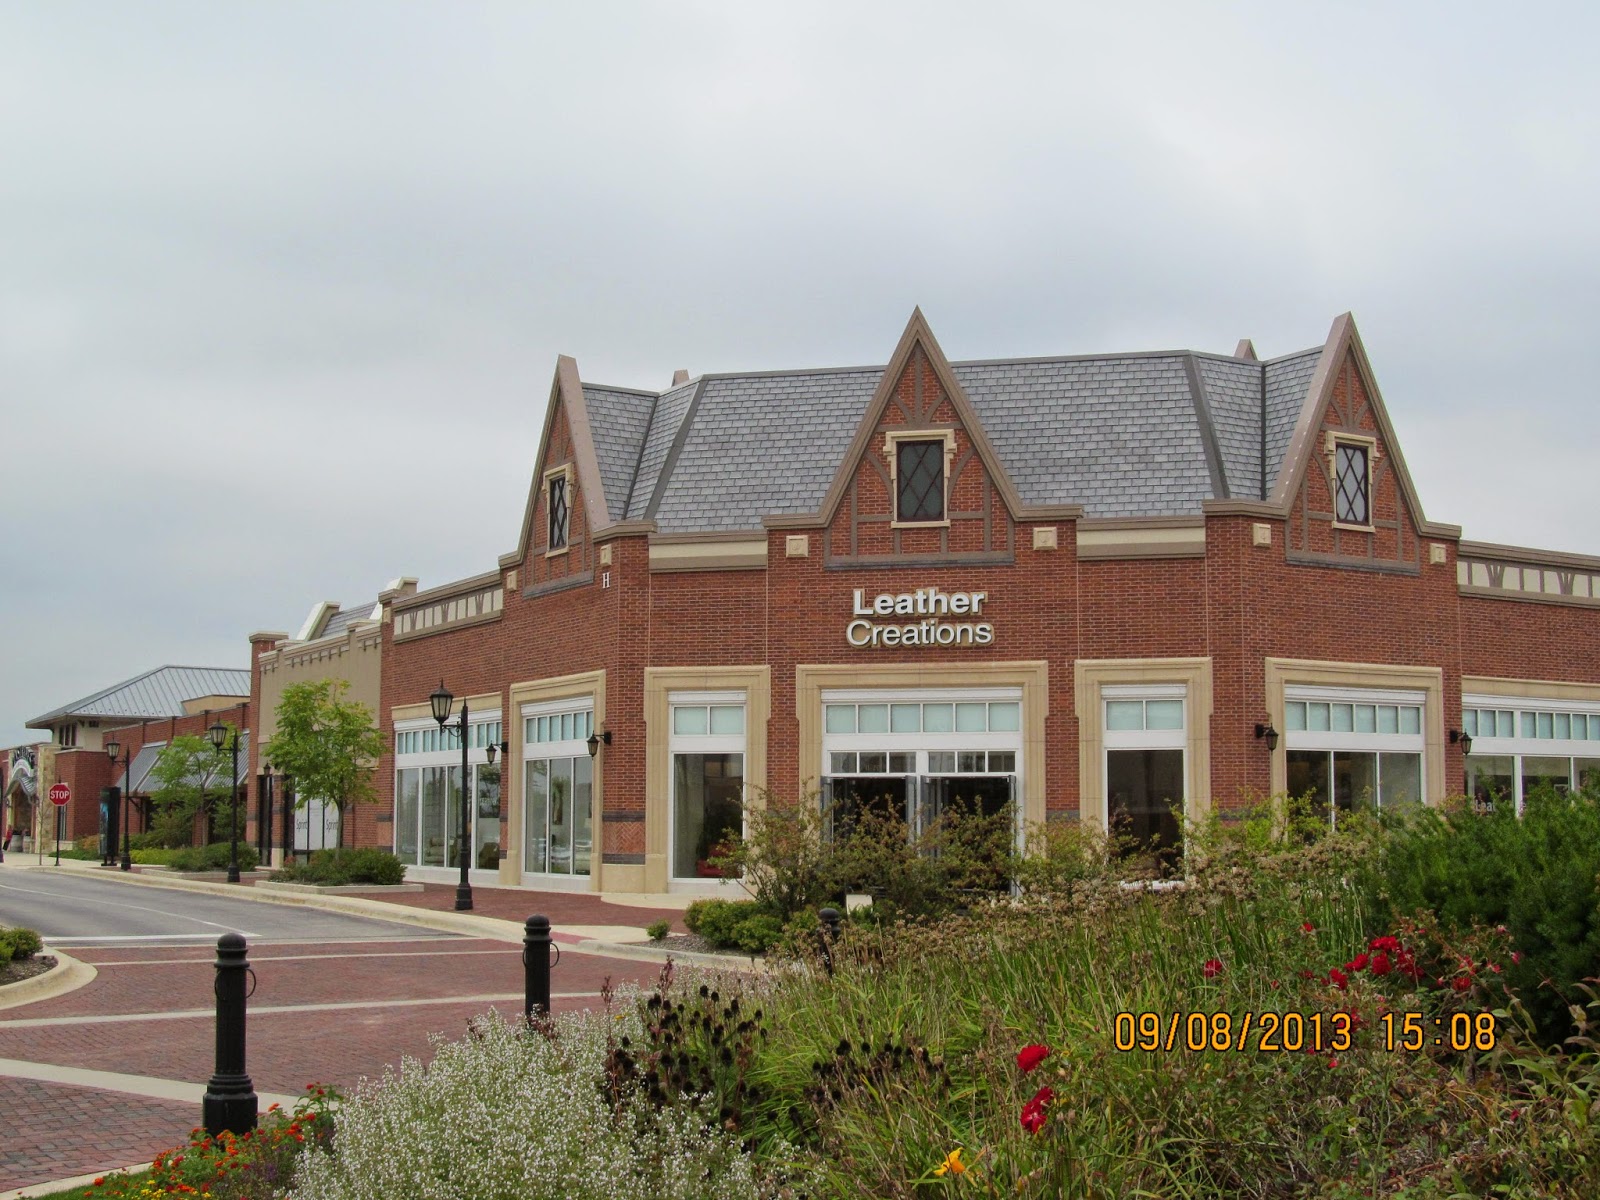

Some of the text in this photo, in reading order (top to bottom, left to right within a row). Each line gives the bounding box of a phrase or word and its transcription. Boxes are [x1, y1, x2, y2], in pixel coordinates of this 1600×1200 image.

[853, 588, 986, 616] Leather
[847, 619, 993, 646] Creations
[50, 790, 69, 799] STOP
